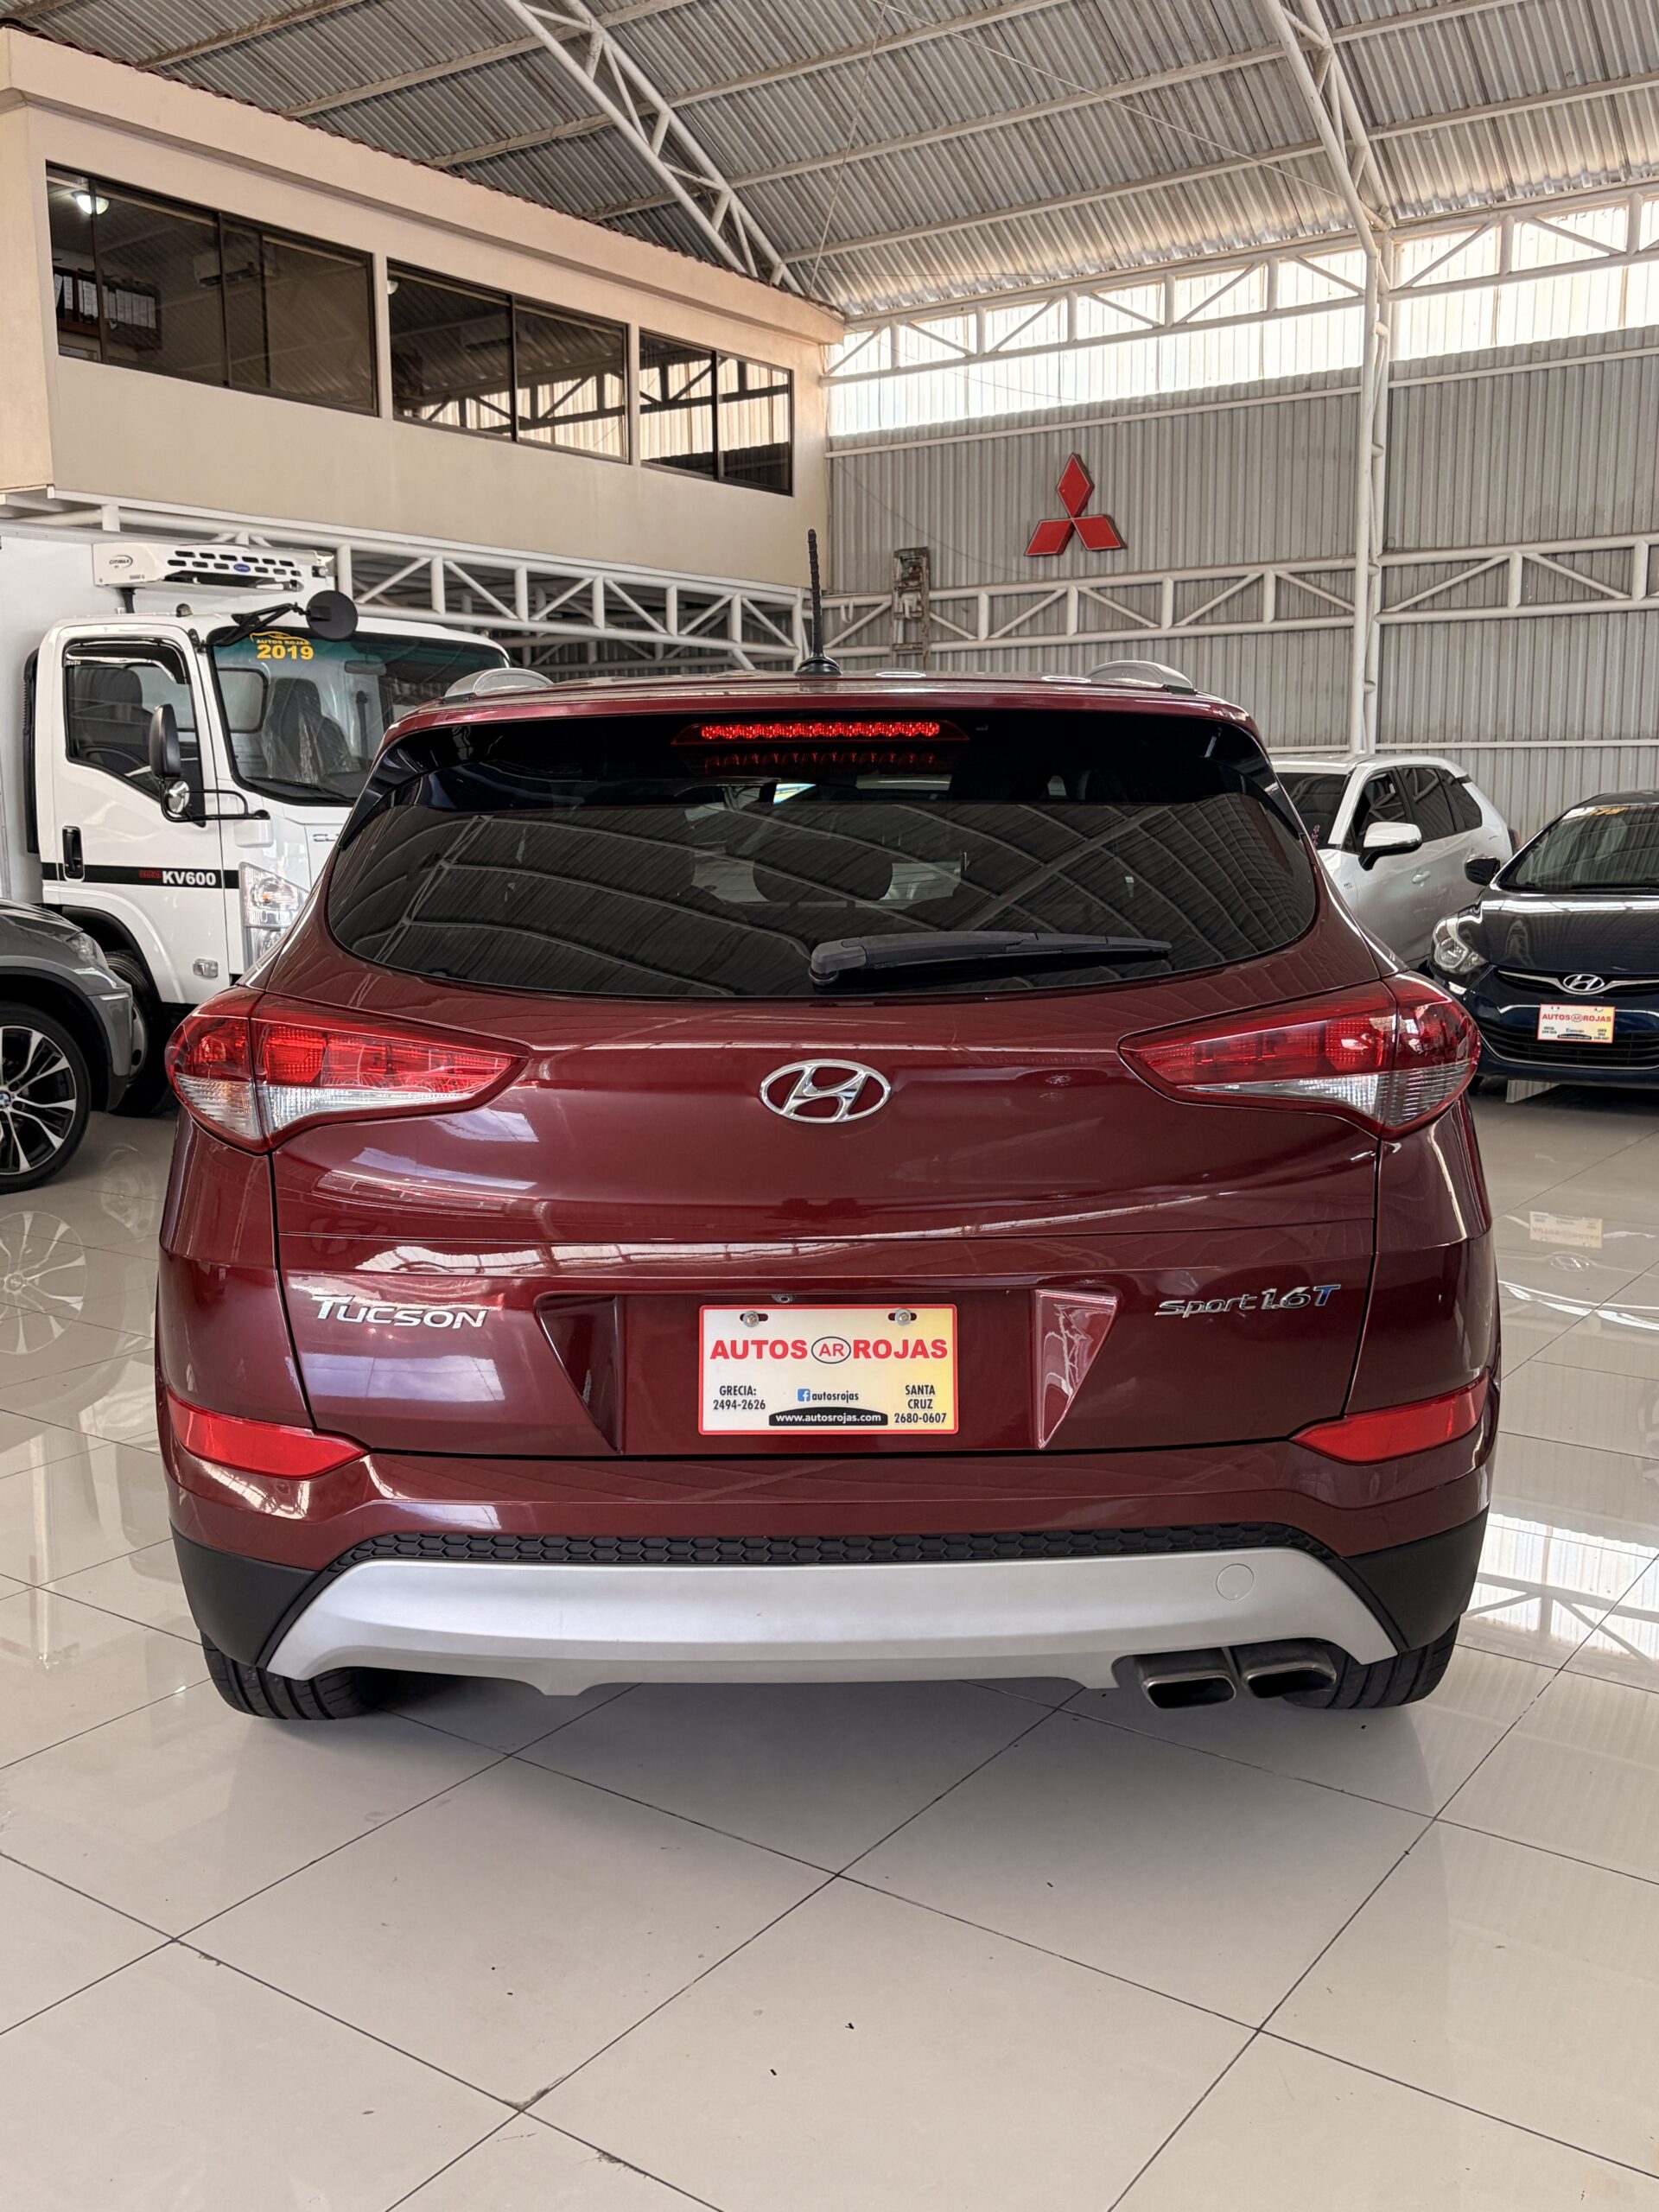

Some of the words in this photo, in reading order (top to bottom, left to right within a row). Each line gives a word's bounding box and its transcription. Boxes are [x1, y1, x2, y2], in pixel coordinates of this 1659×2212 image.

[257, 645, 314, 660] 2019
[162, 870, 217, 886] KV600
[312, 1294, 487, 1329] TUCSON
[1154, 1294, 1257, 1319] Sport
[709, 1339, 809, 1360] AUTOS
[818, 1343, 845, 1357] AR
[853, 1338, 948, 1359] ROJAS
[719, 1385, 757, 1396] GRECIA:
[905, 1384, 936, 1395] SANTA
[811, 1390, 859, 1403] autosrojas
[713, 1399, 766, 1410] 2494-2626
[907, 1399, 933, 1409] CRUZ
[776, 1412, 881, 1425] www.autosrojas.com
[893, 1413, 947, 1423] 2680-0607
